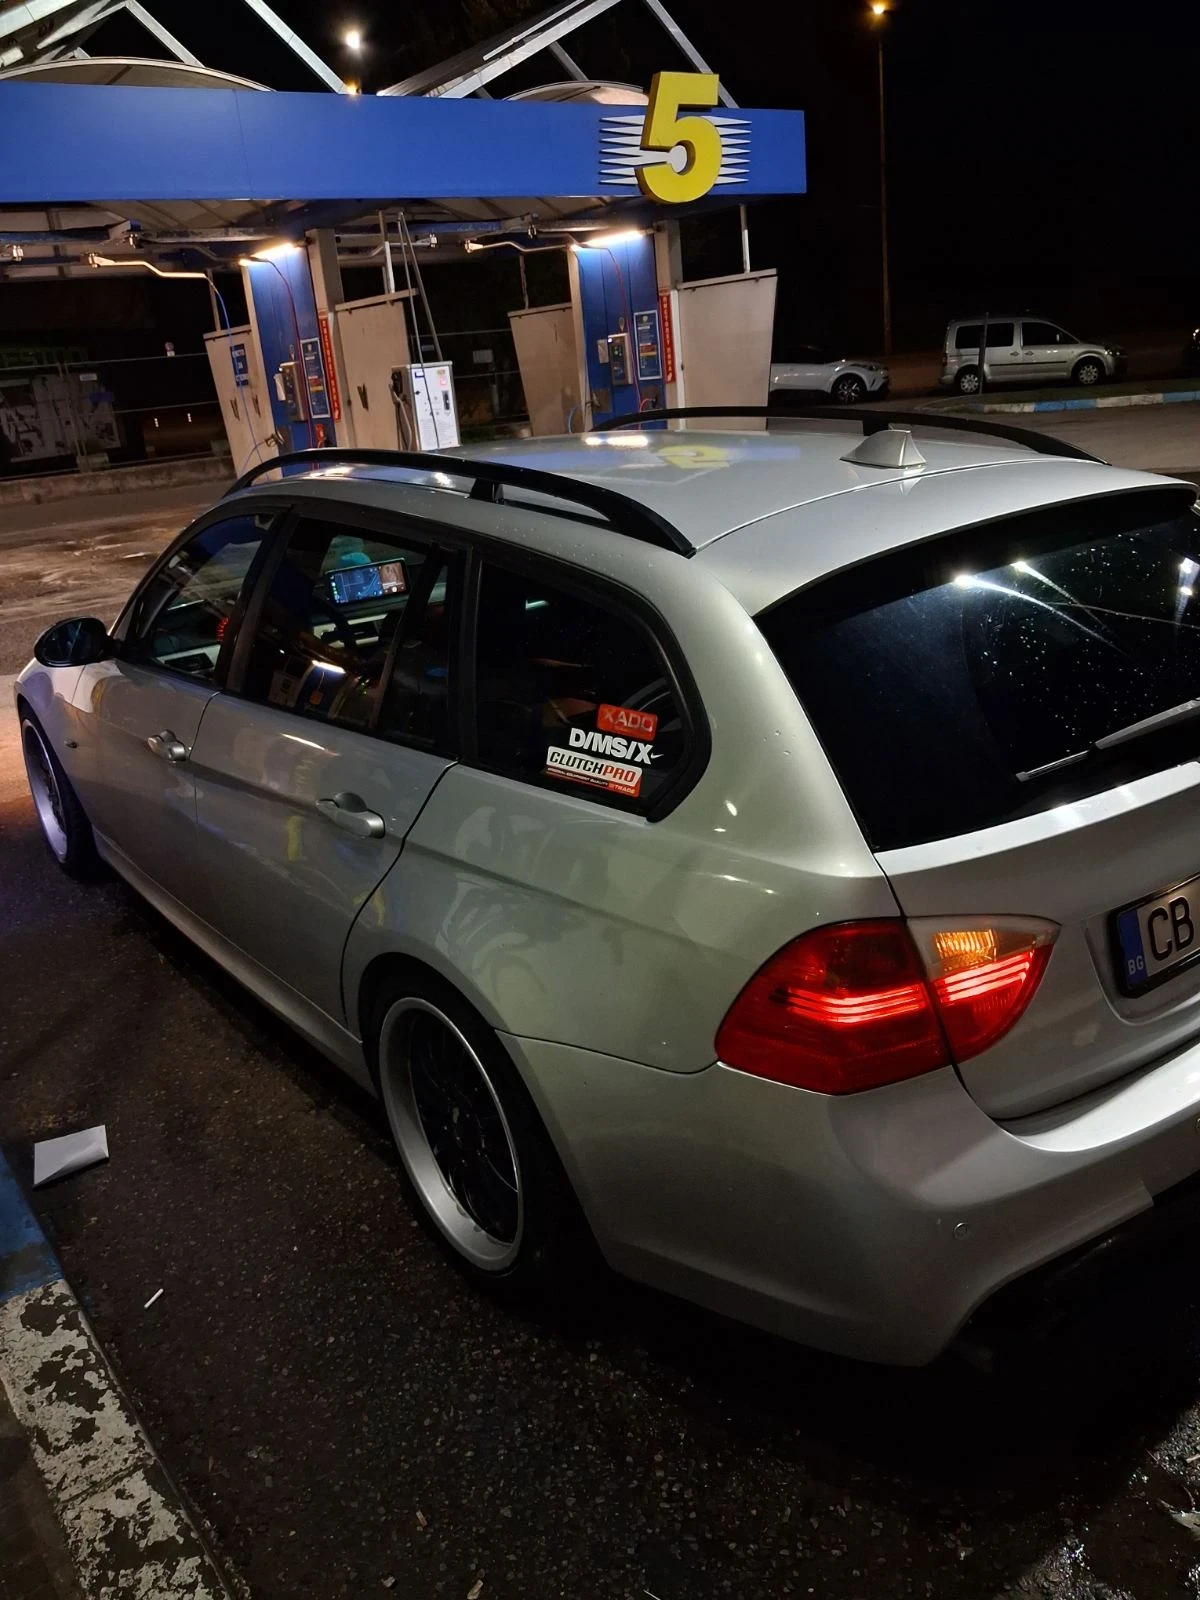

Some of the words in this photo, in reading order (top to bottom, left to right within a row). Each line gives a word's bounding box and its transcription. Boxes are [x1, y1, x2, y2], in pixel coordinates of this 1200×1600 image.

[635, 71, 722, 204] 5
[550, 752, 637, 782] CLUTCHPRO
[1148, 897, 1194, 961] CB
[1127, 955, 1145, 975] BG
